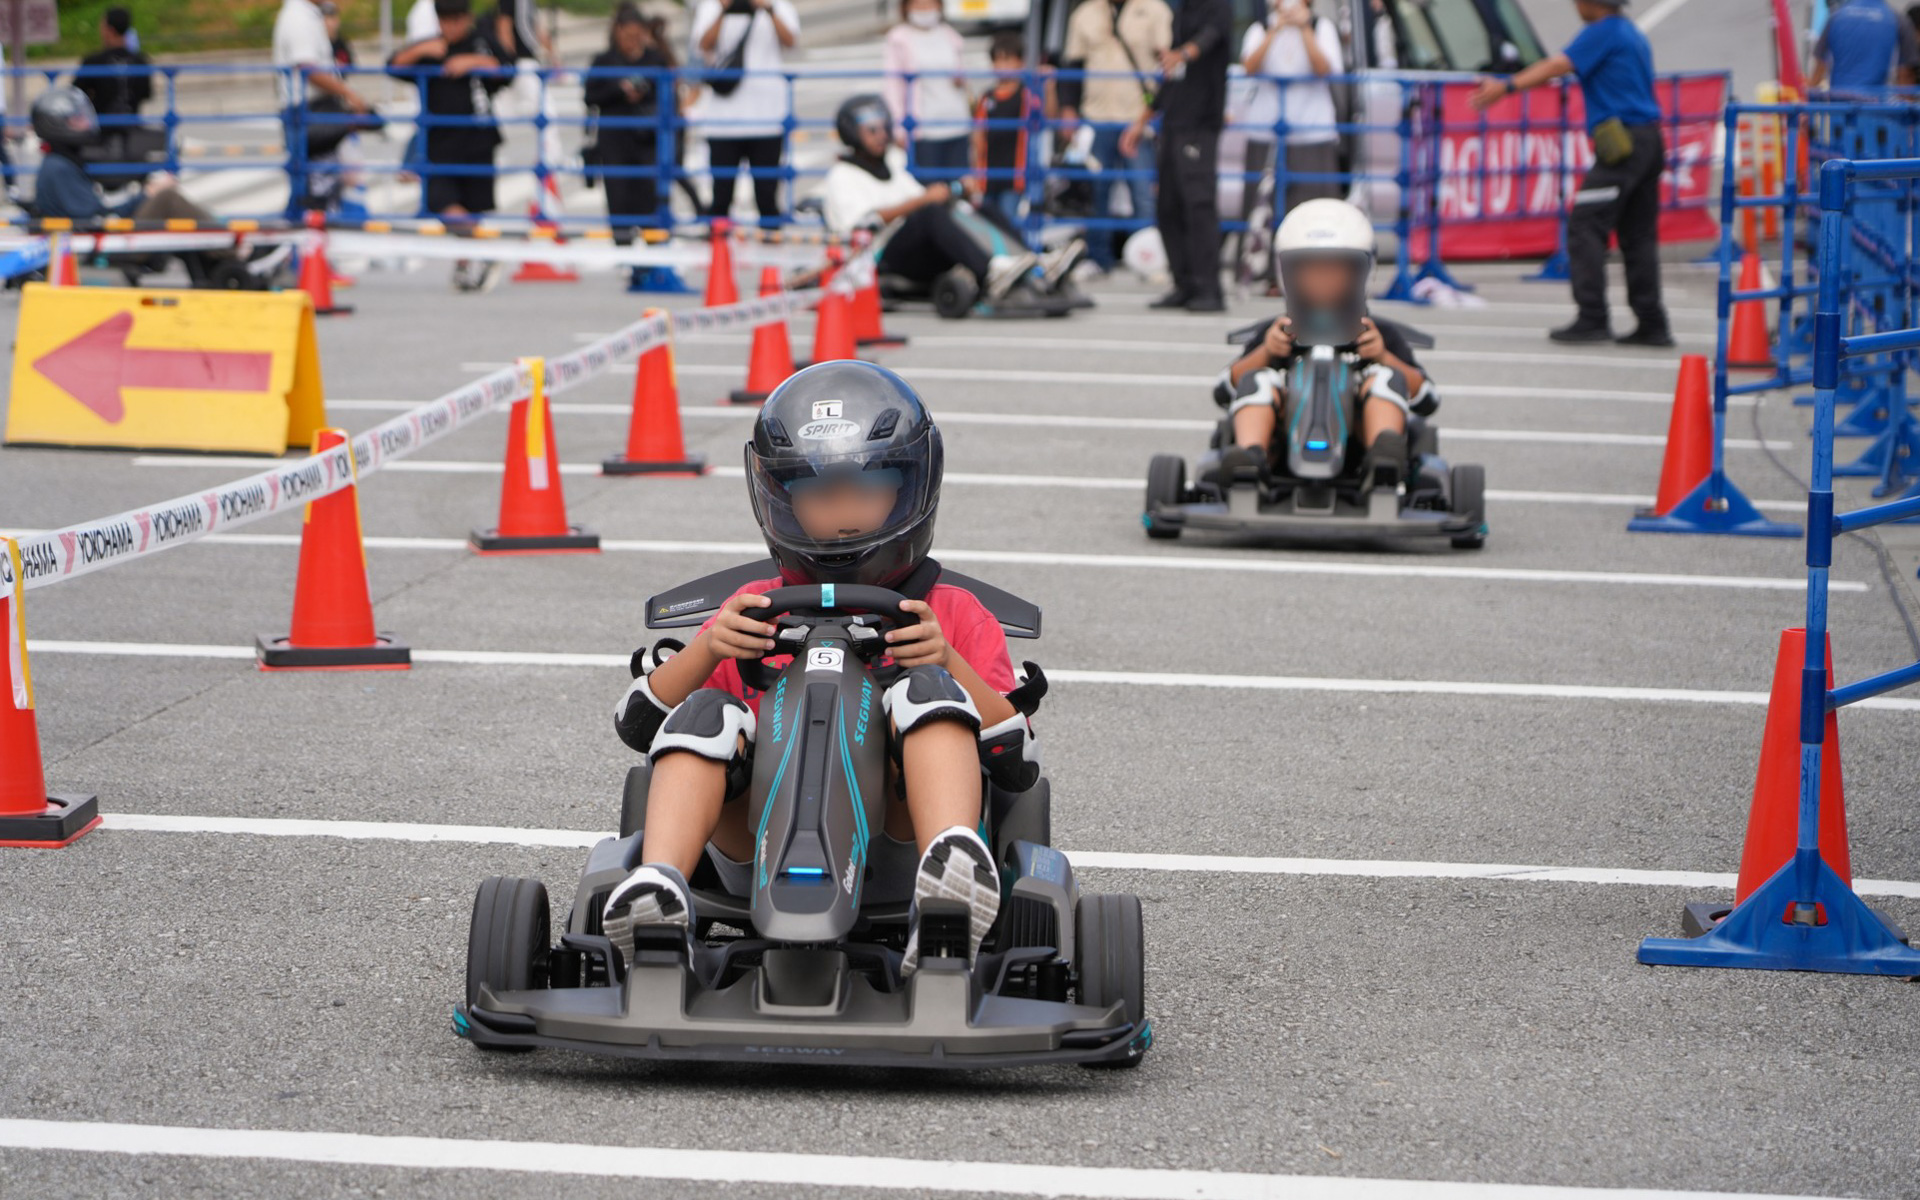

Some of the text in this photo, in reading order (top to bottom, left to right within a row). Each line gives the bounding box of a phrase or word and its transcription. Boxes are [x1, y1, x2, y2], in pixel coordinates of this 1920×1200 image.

[803, 423, 854, 437] SPIRIT
[826, 406, 840, 417] L
[76, 522, 135, 565] YOKOHAMA
[151, 502, 203, 543] YOKOHAMA
[773, 676, 788, 743] SEGWAY
[854, 676, 873, 747] SEGWAY
[744, 1045, 845, 1056] SEGWAY
